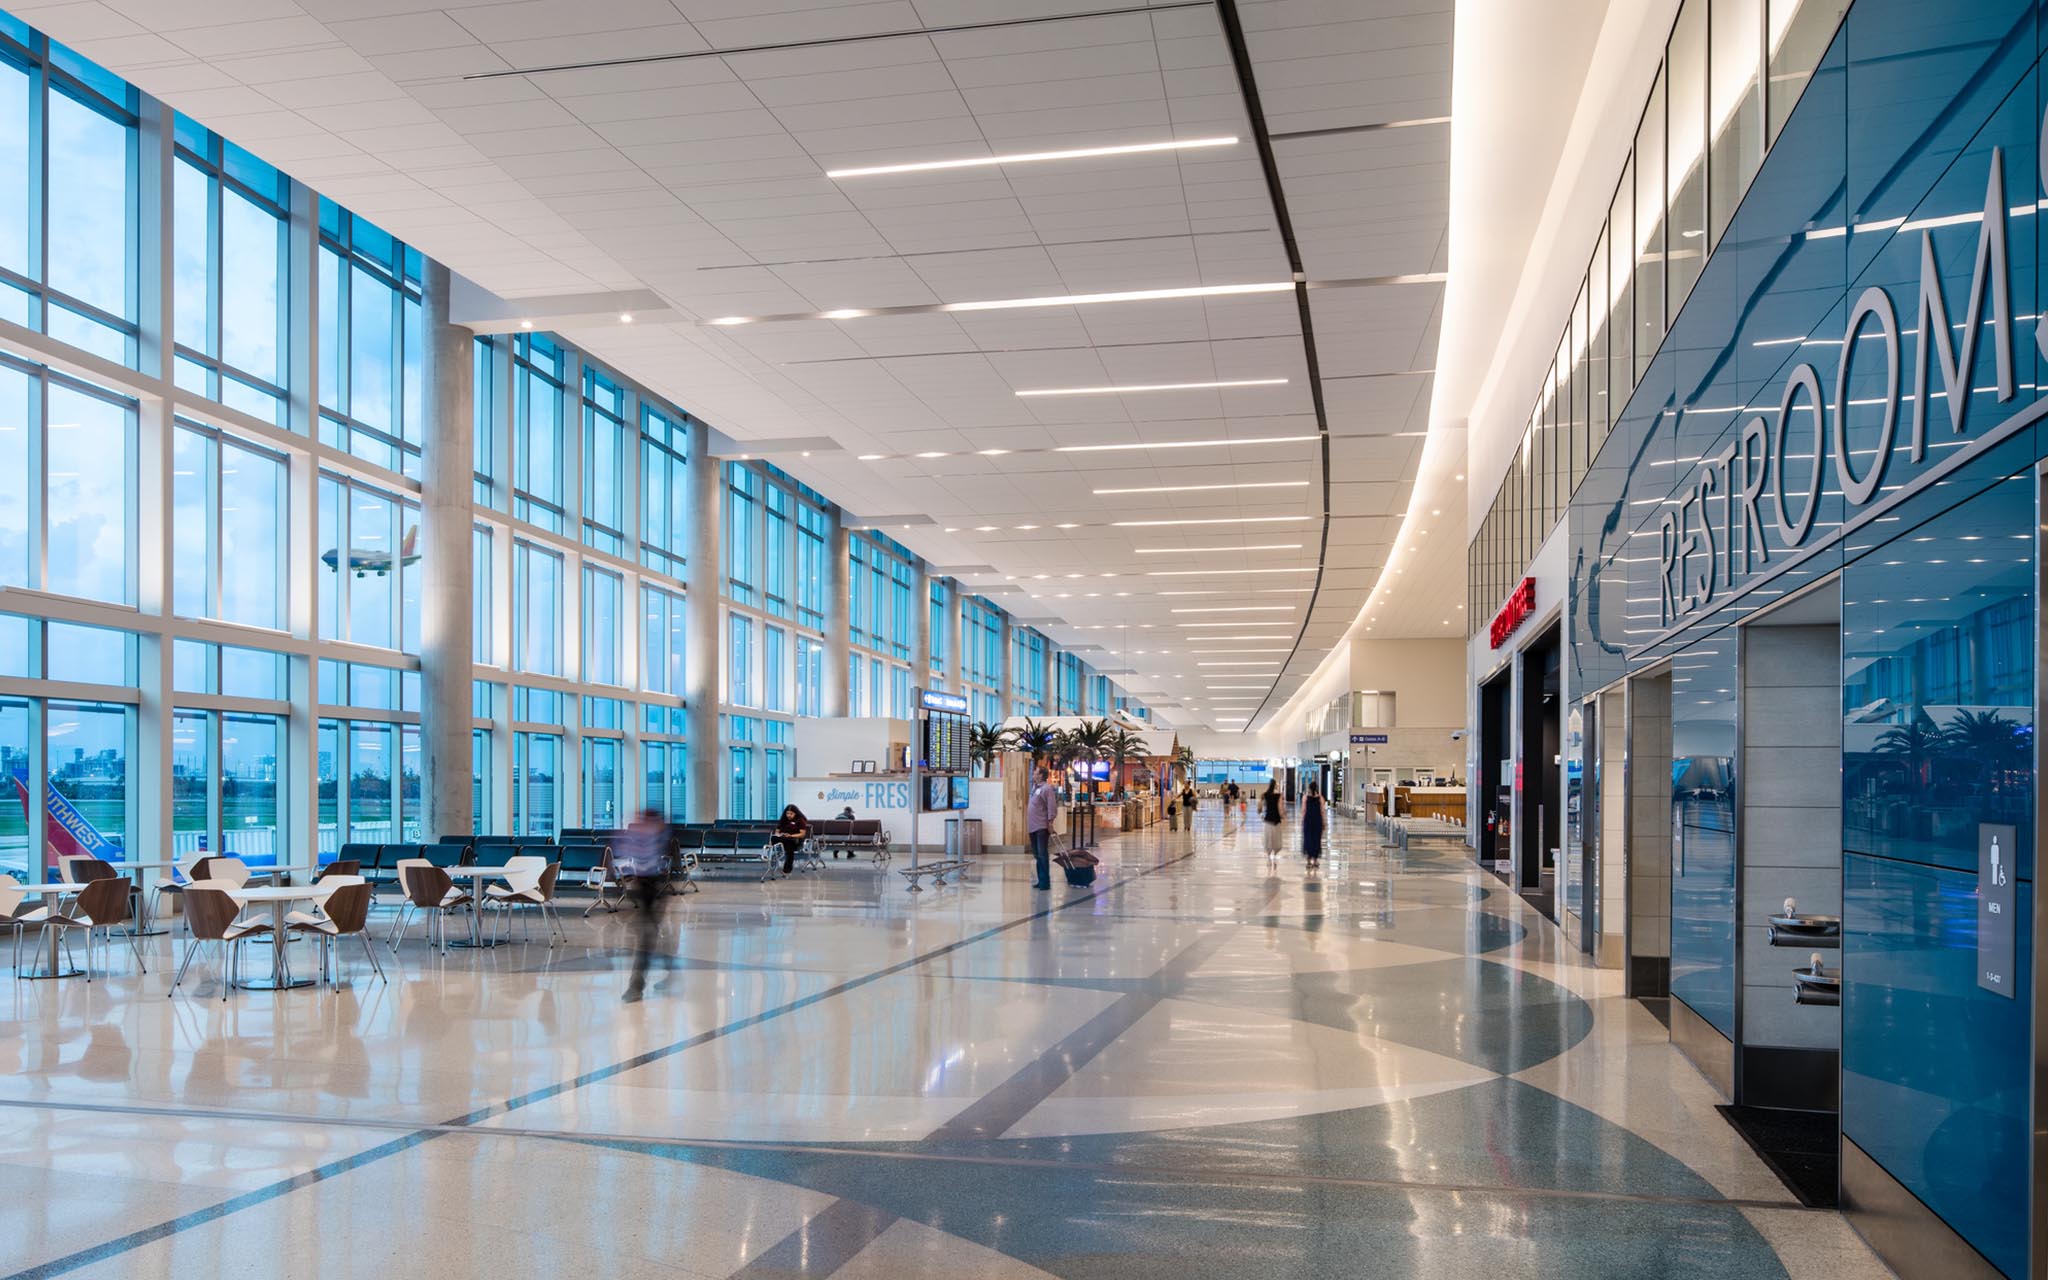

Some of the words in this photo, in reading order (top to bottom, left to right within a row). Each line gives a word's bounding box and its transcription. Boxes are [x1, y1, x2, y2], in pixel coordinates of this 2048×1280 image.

[1660, 102, 2048, 627] RESTROOM
[26, 779, 104, 850] UTHWEST
[827, 787, 860, 802] Simple
[865, 783, 912, 808] FRES
[1988, 902, 2001, 914] MEN
